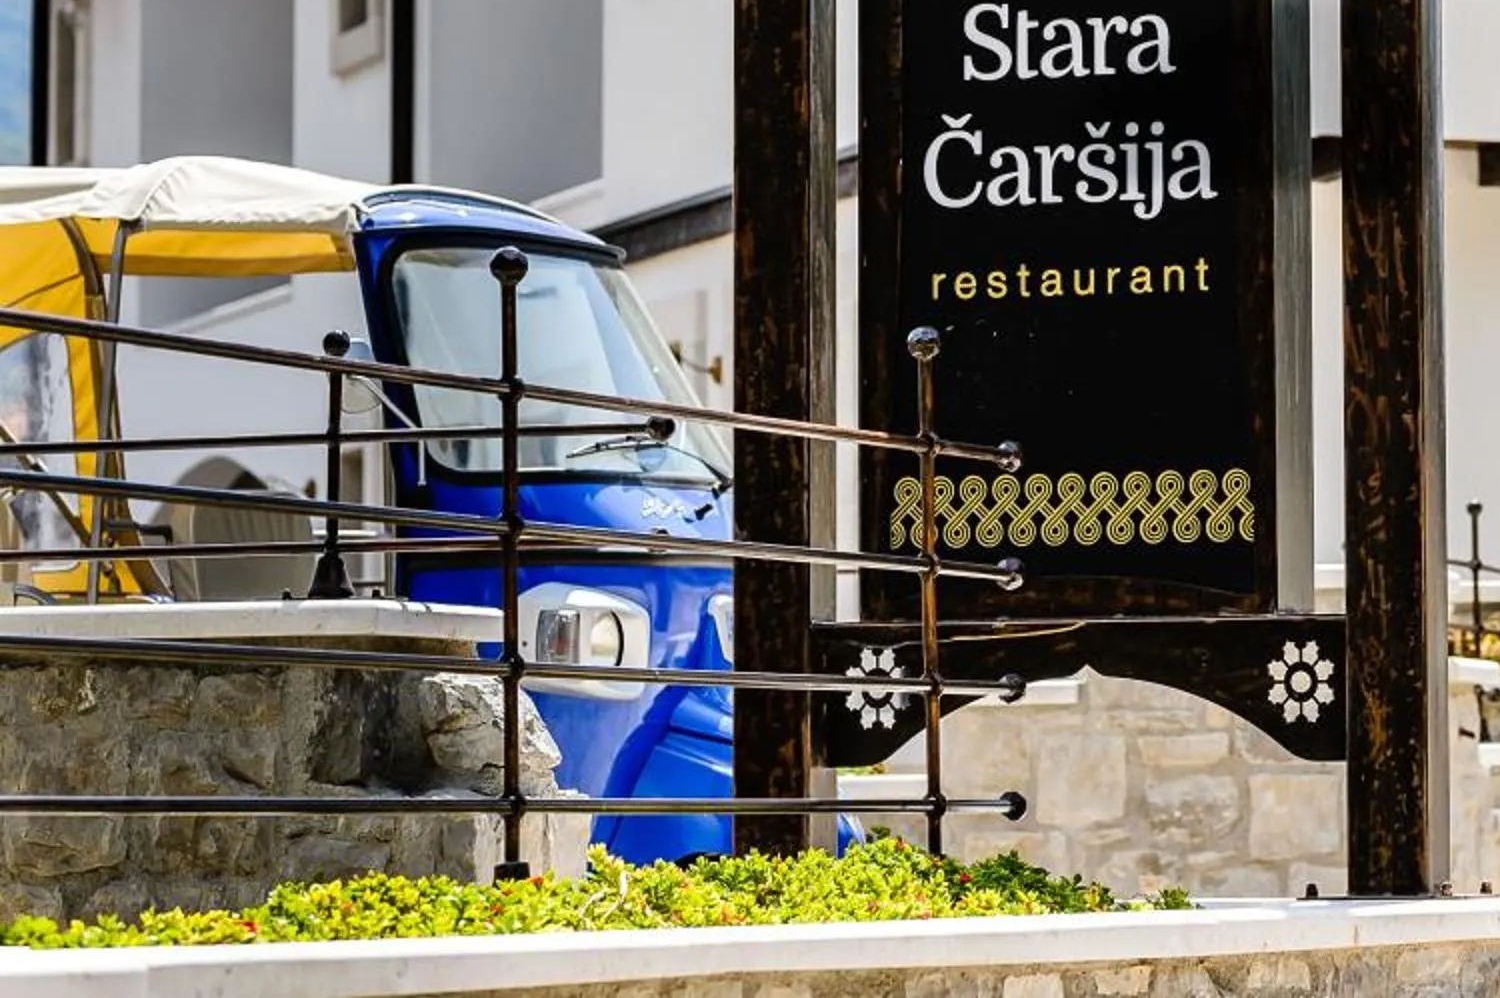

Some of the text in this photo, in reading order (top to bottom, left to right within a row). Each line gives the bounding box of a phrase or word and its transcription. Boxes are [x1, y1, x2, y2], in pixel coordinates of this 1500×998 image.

[963, 3, 1176, 81] Stara
[923, 113, 1219, 220] Čaršija
[931, 257, 1210, 300] restaurant
